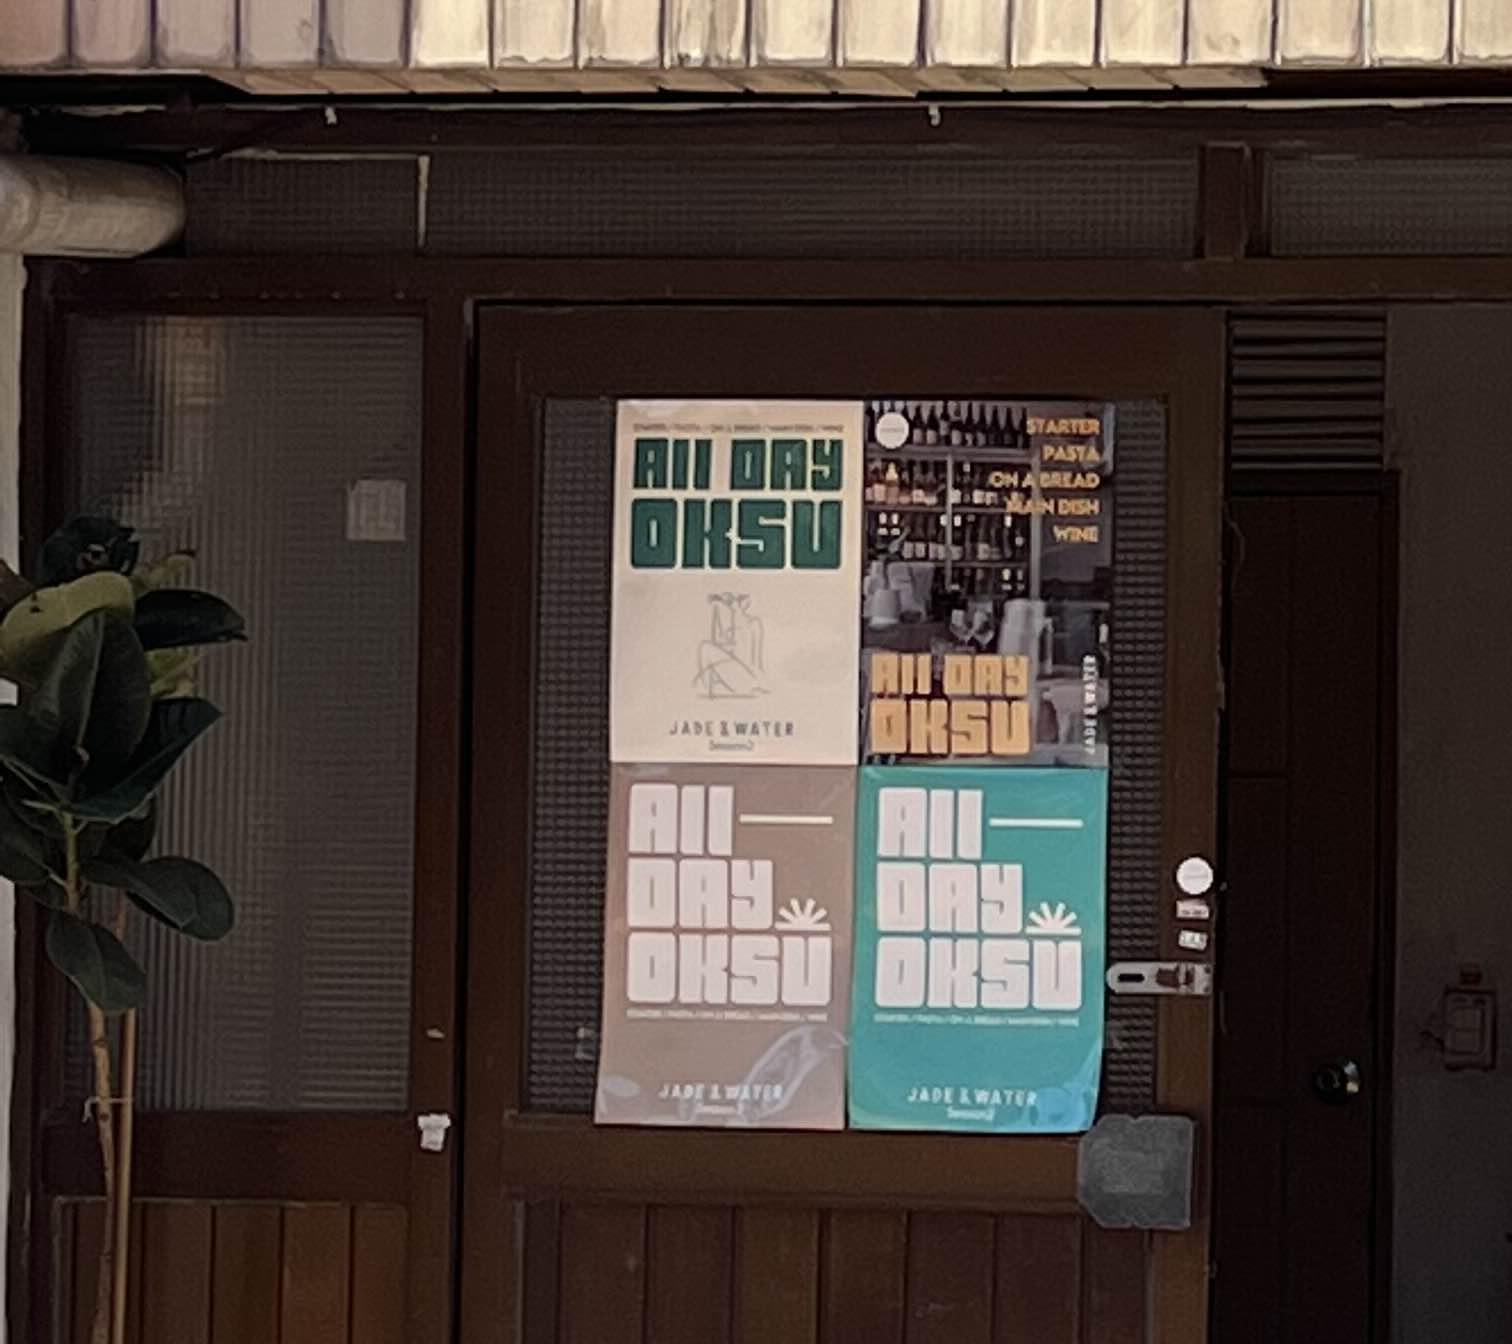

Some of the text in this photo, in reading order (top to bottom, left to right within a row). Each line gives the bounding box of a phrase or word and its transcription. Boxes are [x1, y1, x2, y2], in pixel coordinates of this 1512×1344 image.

[1026, 417, 1099, 435] STARTER
[729, 439, 843, 491] DAY
[1043, 444, 1099, 462] PASTA
[990, 472, 1100, 488] ON A BREAD
[1006, 499, 1099, 515] MAIN DISH
[631, 498, 843, 569] OKSU
[1053, 525, 1099, 543] WINE
[943, 654, 1029, 695] DAY
[669, 720, 714, 737] JADE
[734, 720, 794, 737] WATER
[870, 700, 1030, 754] OKSU
[627, 858, 774, 930] DAY
[877, 862, 1023, 934] DAY
[627, 932, 832, 1005] OKSU
[875, 937, 1082, 1010] OKSU
[658, 1083, 704, 1099] JADE
[724, 1083, 784, 1099] WATER
[907, 1087, 954, 1103] JADE
[974, 1089, 1039, 1106] WATER
